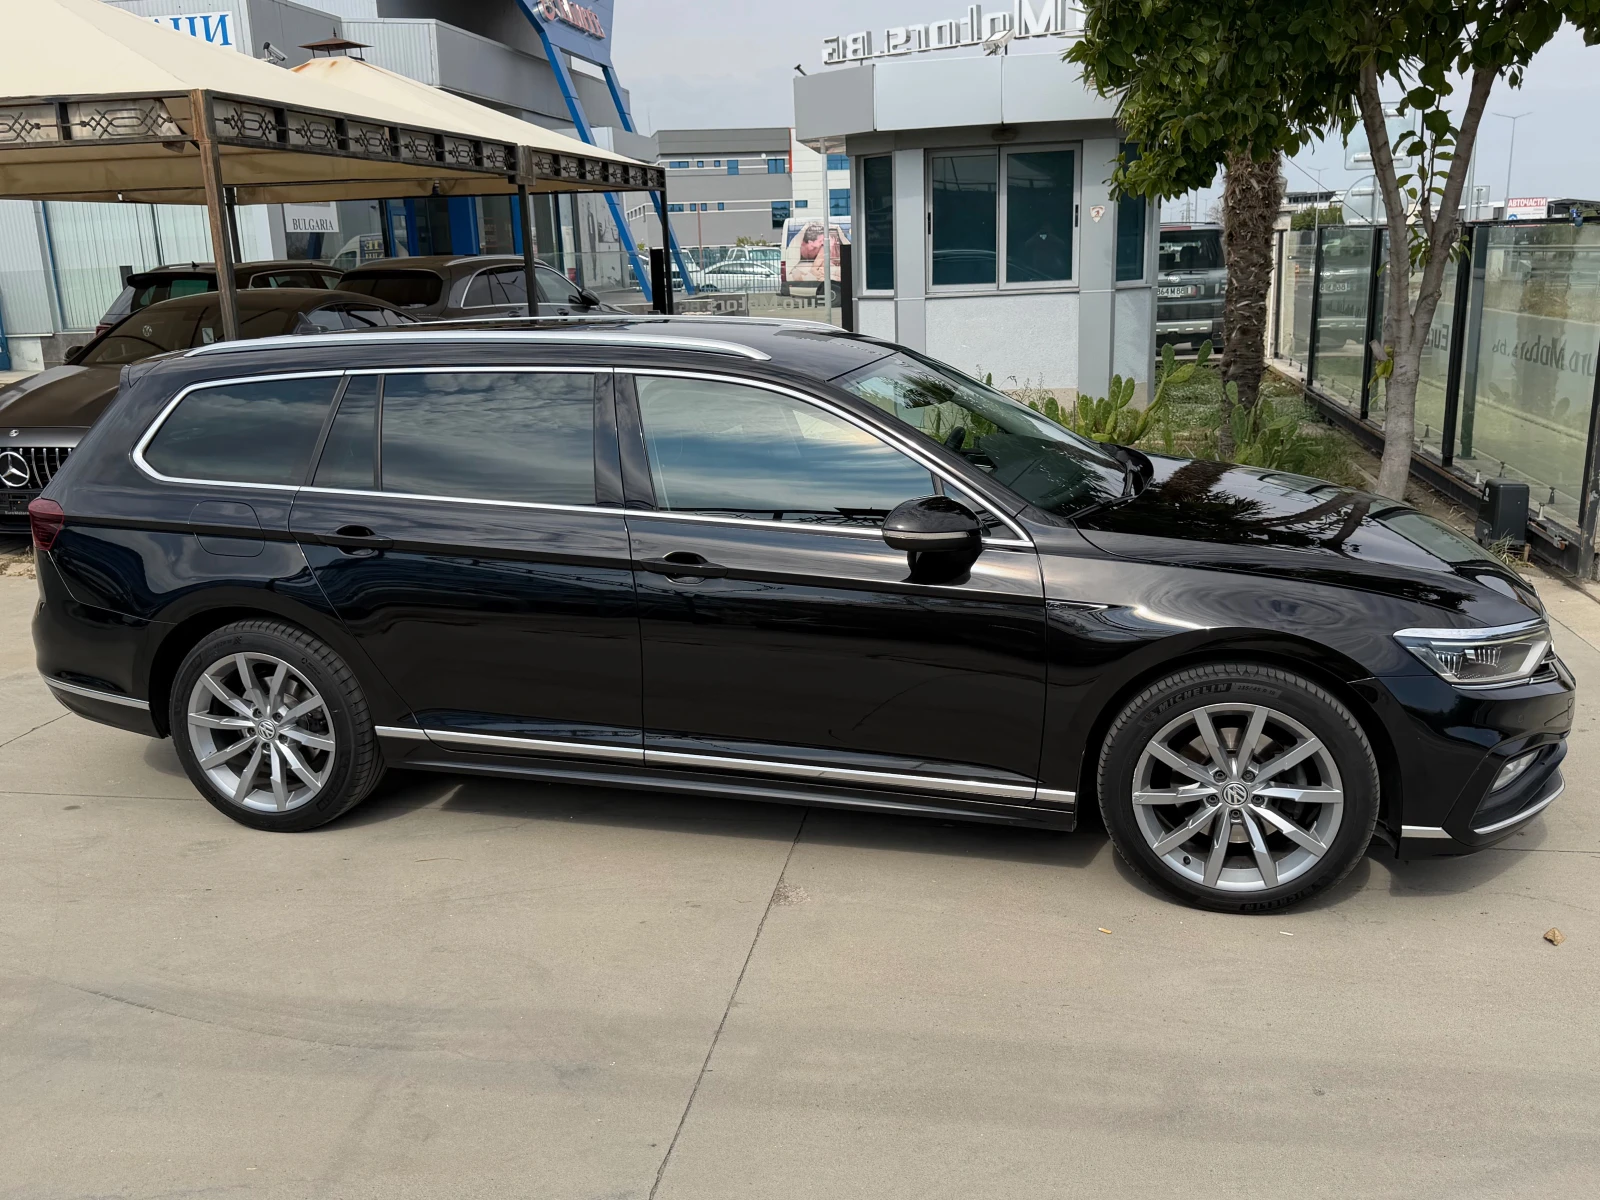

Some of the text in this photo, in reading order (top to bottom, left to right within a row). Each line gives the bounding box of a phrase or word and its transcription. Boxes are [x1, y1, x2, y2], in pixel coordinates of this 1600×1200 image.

[1508, 198, 1546, 207] АВТОЧАСТИ
[292, 218, 334, 231] BULGARIA
[1158, 683, 1229, 714] MICHELIN
